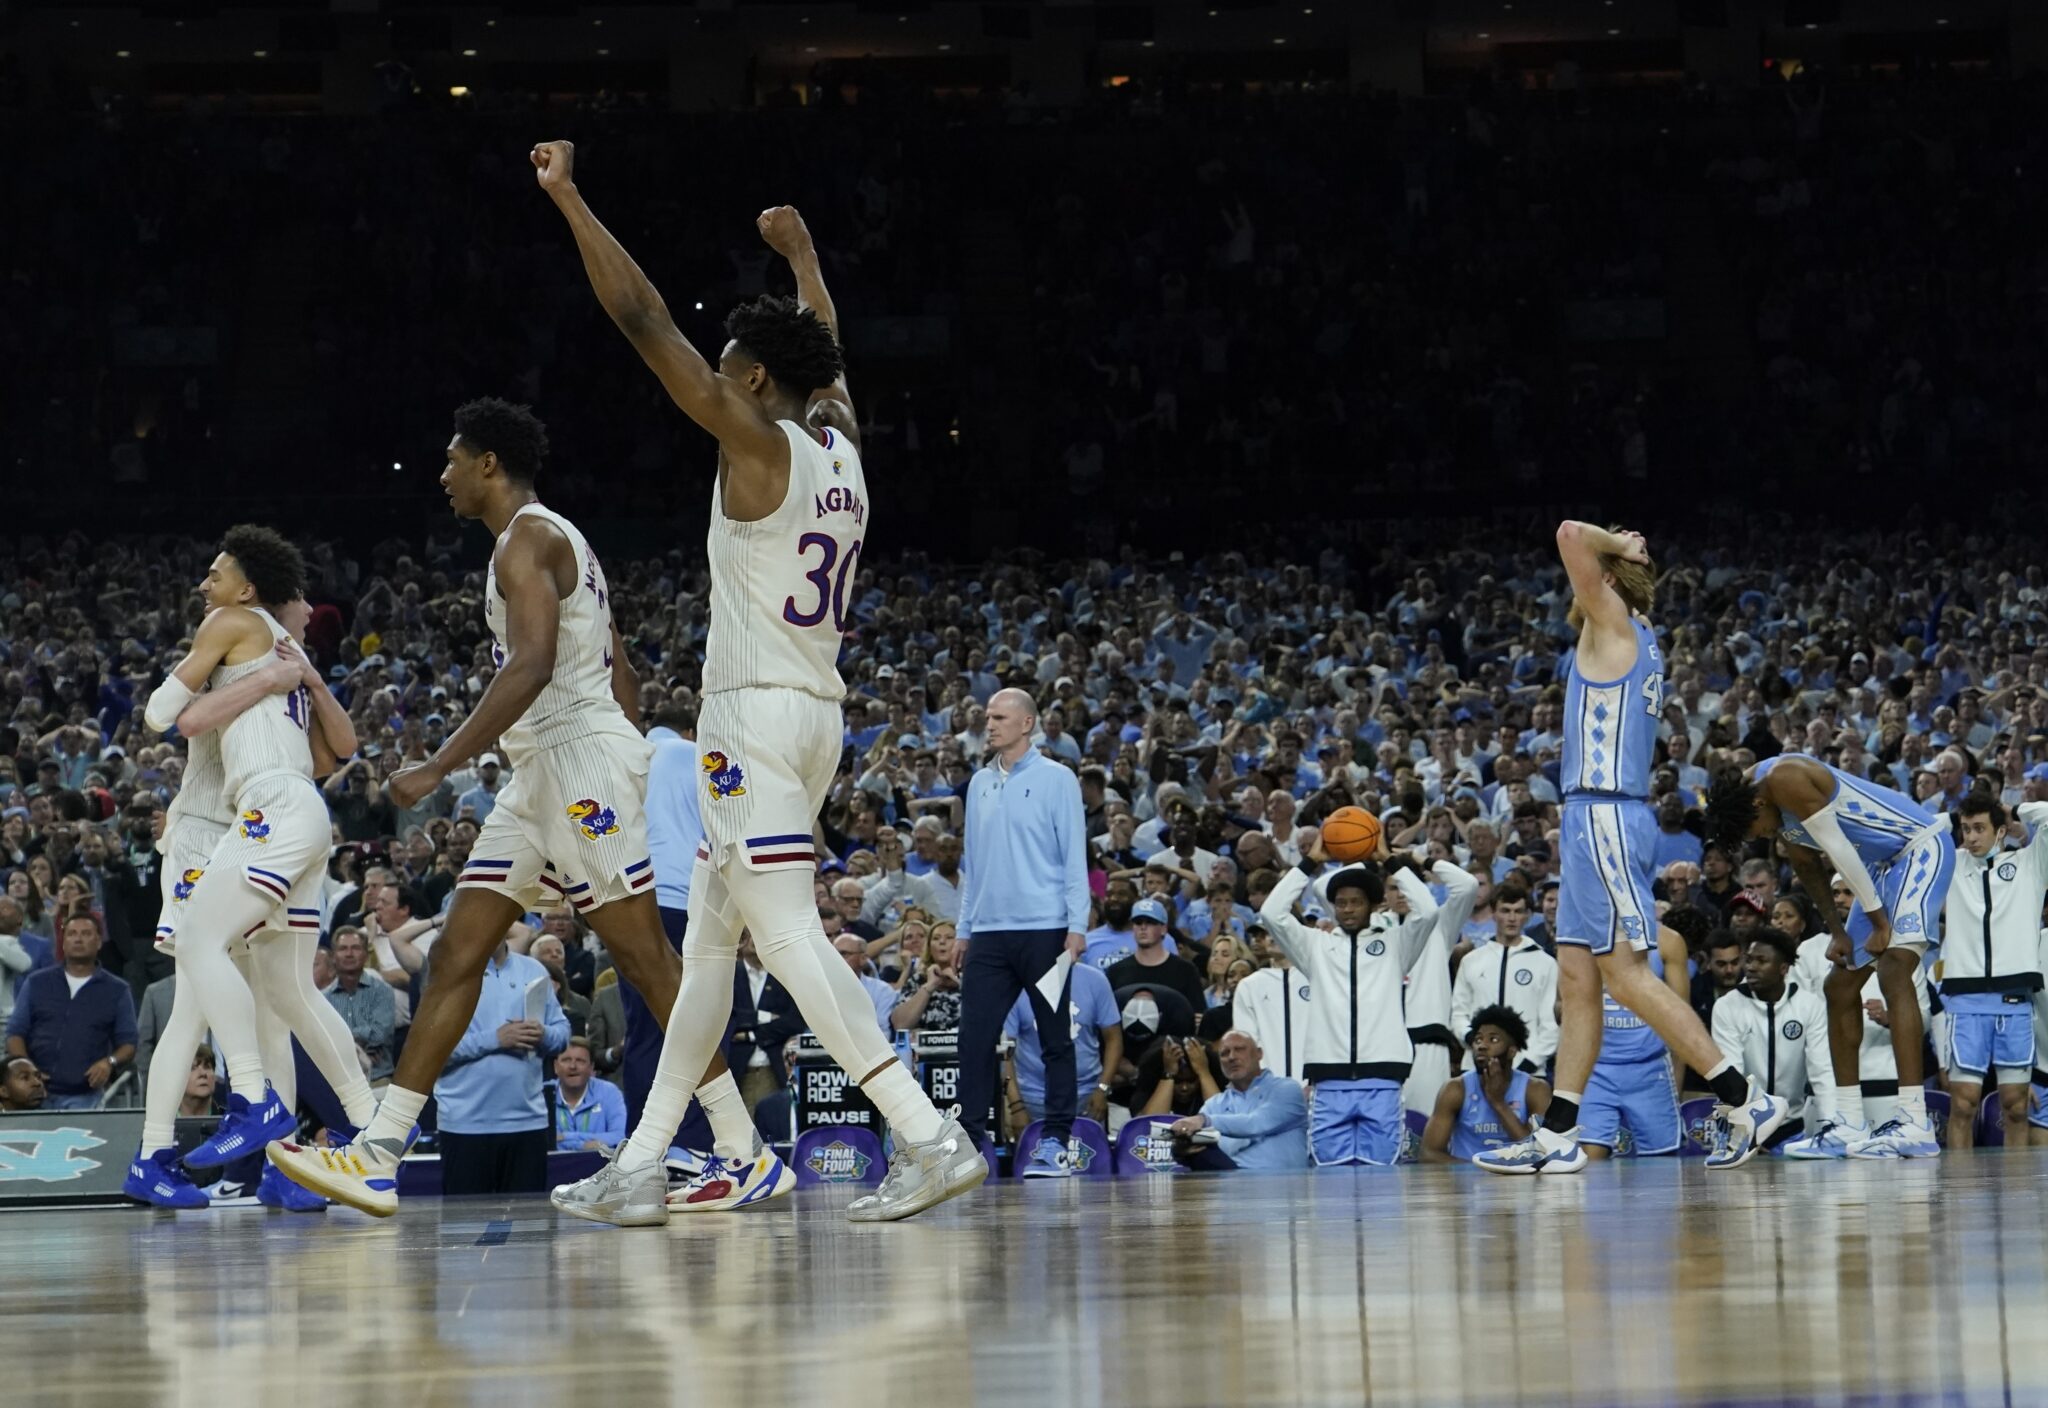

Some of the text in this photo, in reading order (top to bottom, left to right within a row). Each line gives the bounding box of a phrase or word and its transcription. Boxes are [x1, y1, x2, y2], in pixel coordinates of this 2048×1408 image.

[719, 775, 732, 786] KU
[593, 816, 606, 828] KU
[807, 1087, 842, 1103] ADE
[807, 1111, 870, 1124] PAUSE
[824, 1148, 856, 1160] FINAL
[823, 1159, 855, 1173] FOUR
